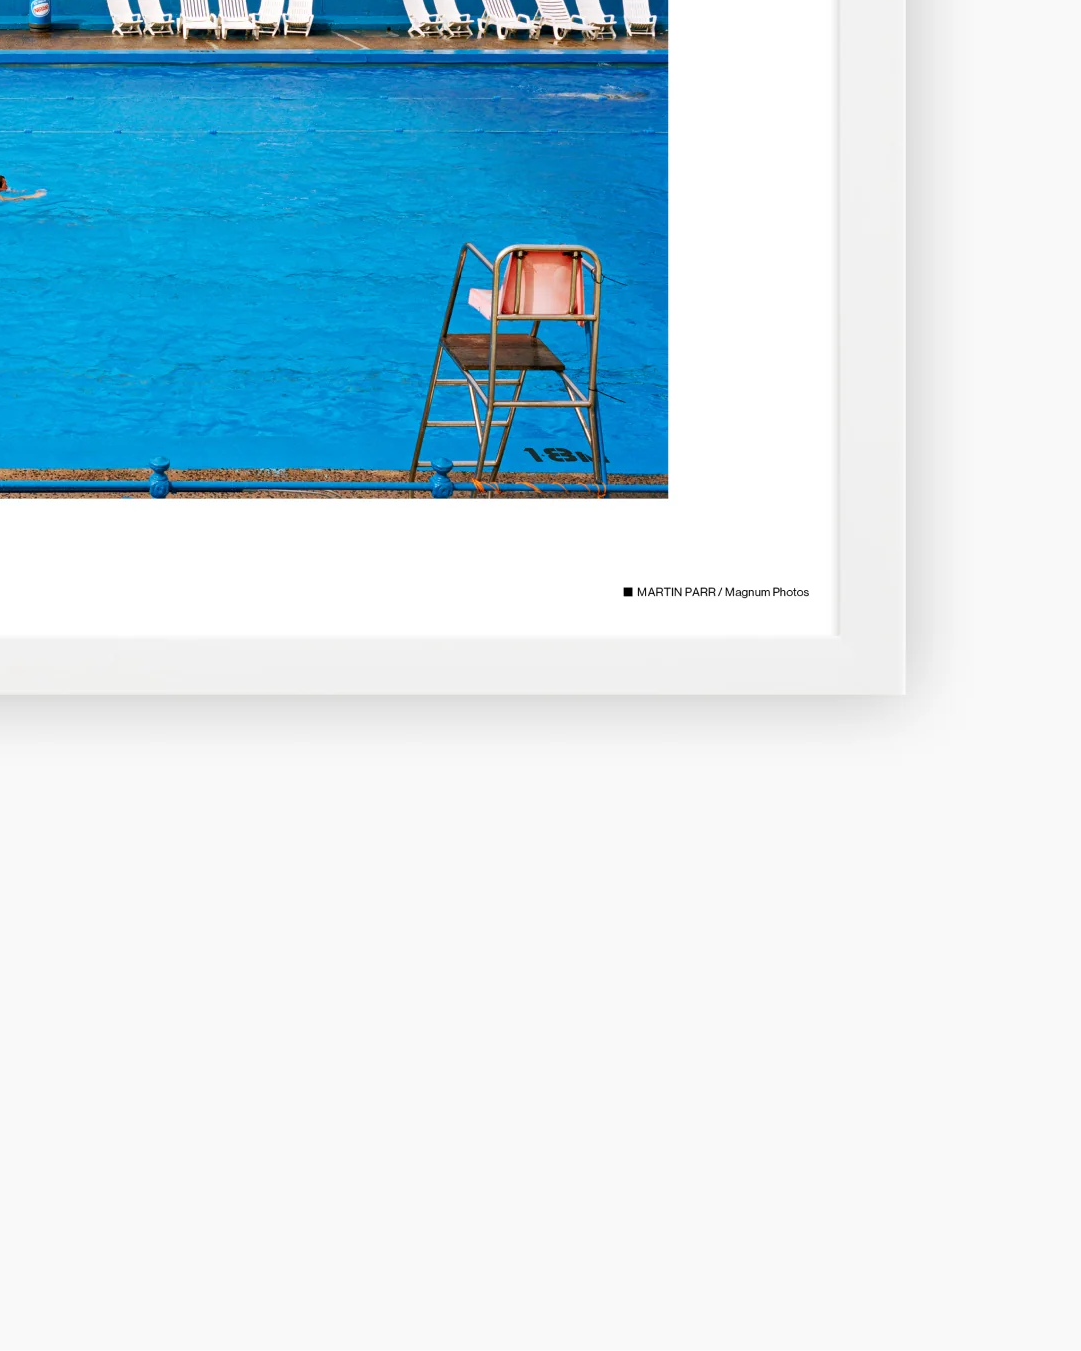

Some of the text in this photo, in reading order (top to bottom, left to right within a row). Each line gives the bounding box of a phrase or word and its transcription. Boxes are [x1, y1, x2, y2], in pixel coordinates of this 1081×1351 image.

[638, 587, 810, 598] MARTIN PARR / Magnum Photos
